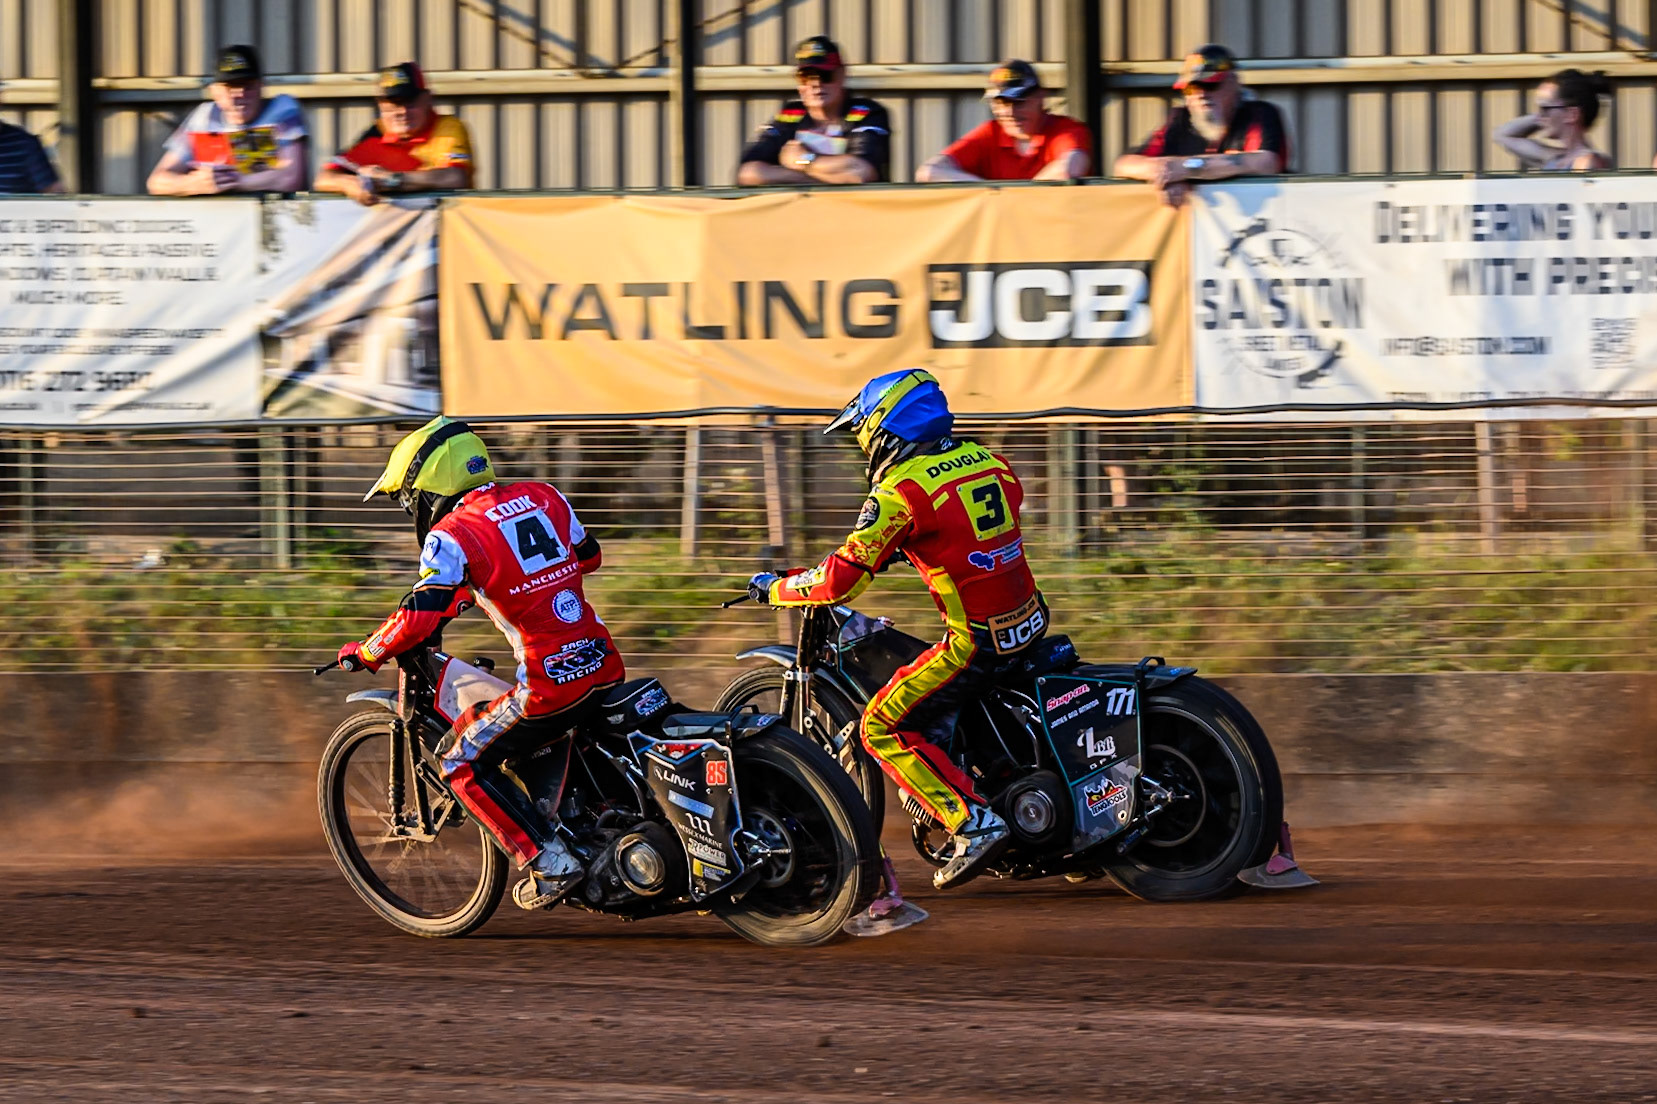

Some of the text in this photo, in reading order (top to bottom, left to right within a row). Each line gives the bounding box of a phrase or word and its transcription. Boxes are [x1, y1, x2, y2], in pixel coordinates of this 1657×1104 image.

[1372, 200, 1573, 243] DELIVERING
[1444, 256, 1657, 296] WITH PRECI
[468, 267, 1153, 342] WATLING JCB
[926, 450, 991, 479] DOUGLA
[484, 494, 538, 523] COOK
[971, 482, 1006, 532] 3
[515, 515, 562, 562] 4
[509, 561, 579, 596] MANCHESTE
[999, 610, 1045, 649] JCB
[557, 661, 603, 685] RACING
[1105, 687, 1136, 716] 171
[663, 769, 697, 792] LINK
